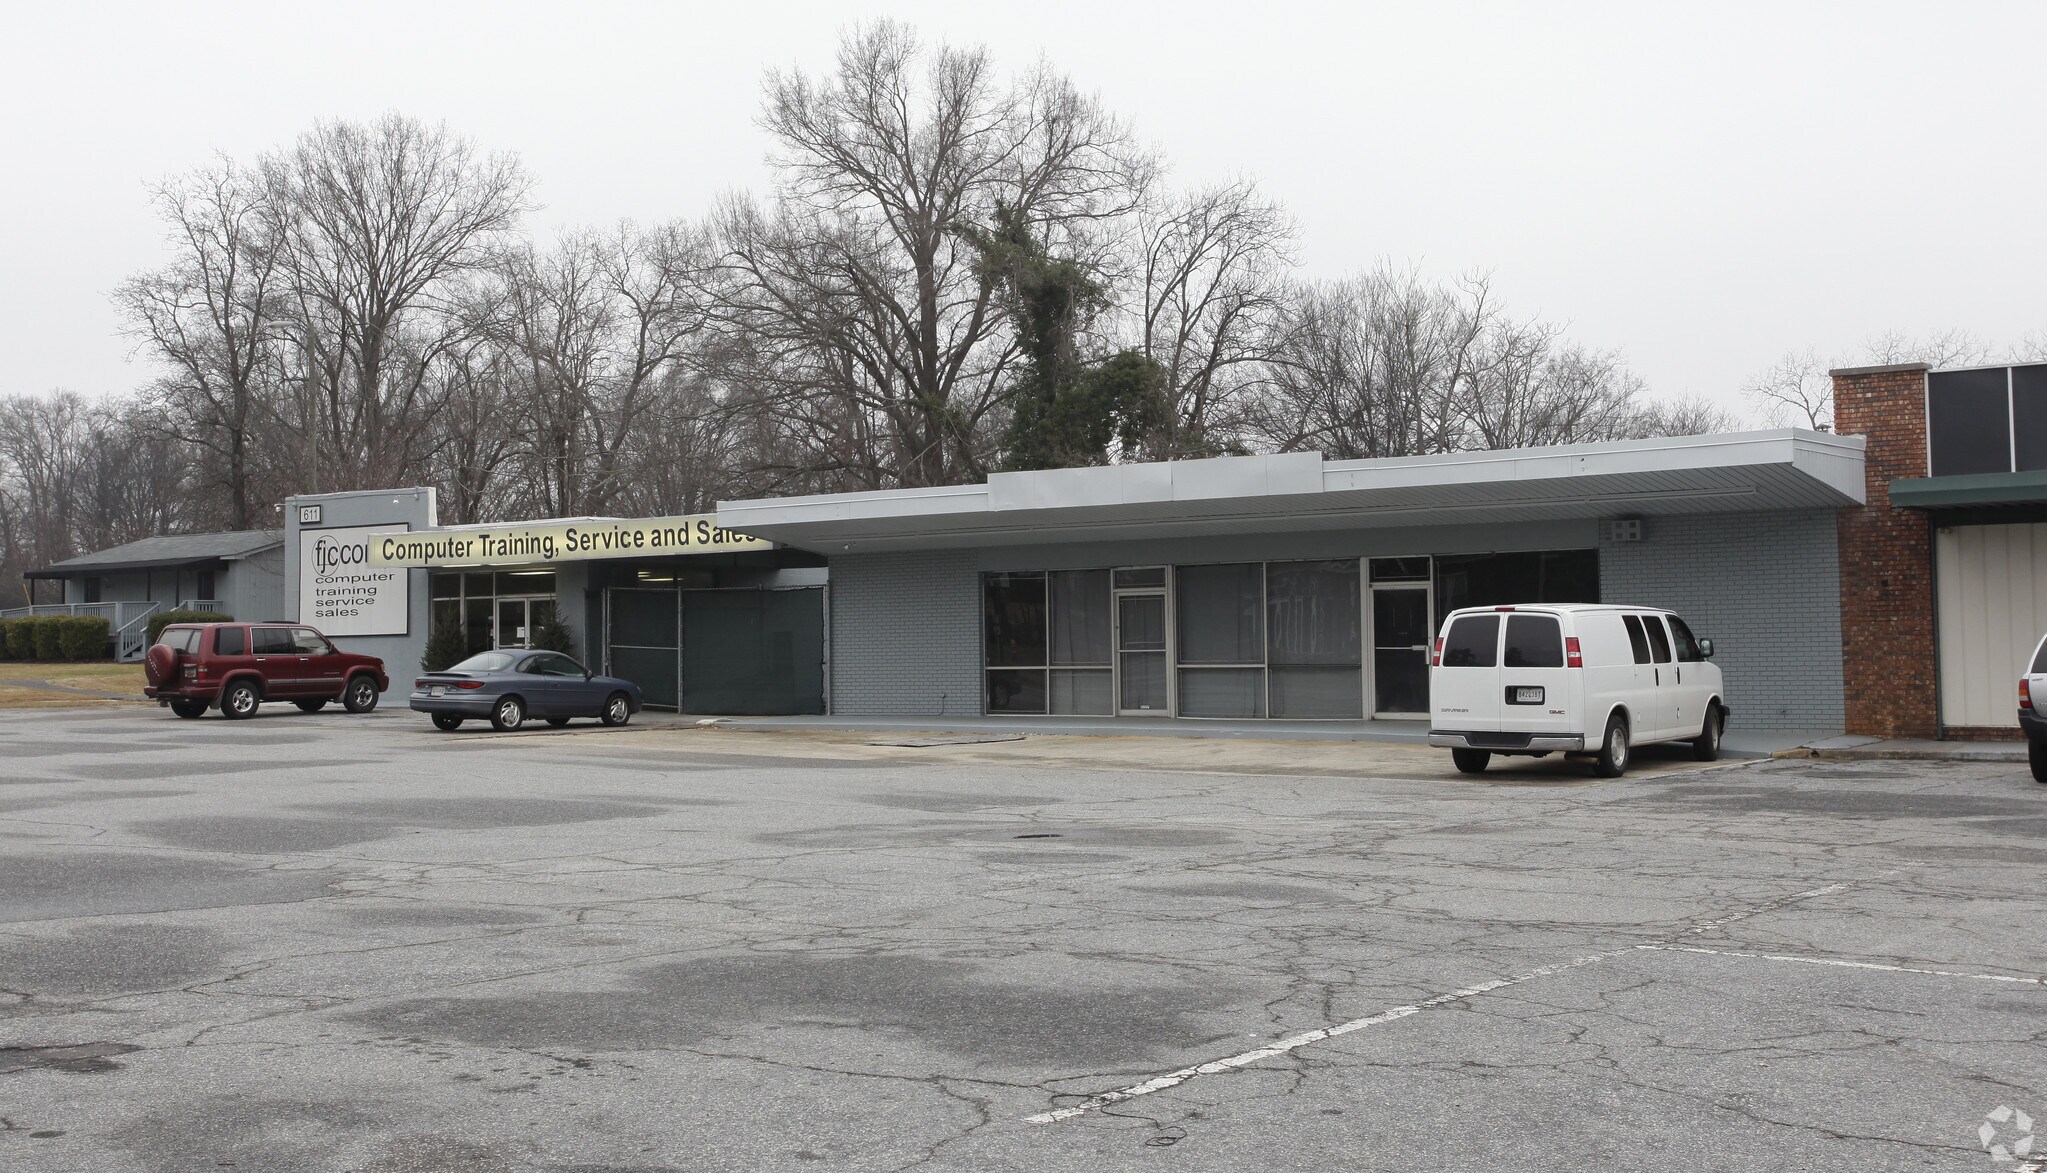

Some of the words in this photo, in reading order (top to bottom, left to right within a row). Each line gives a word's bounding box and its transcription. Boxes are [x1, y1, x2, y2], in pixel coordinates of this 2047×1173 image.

[304, 509, 318, 520] 611
[382, 538, 473, 564] Computer
[478, 532, 559, 559] Training,
[566, 525, 644, 551] Service
[651, 521, 689, 547] and
[315, 540, 368, 574] fjcco
[315, 573, 396, 585] computer
[315, 587, 378, 597] training
[315, 597, 375, 607] service
[315, 608, 359, 618] sales
